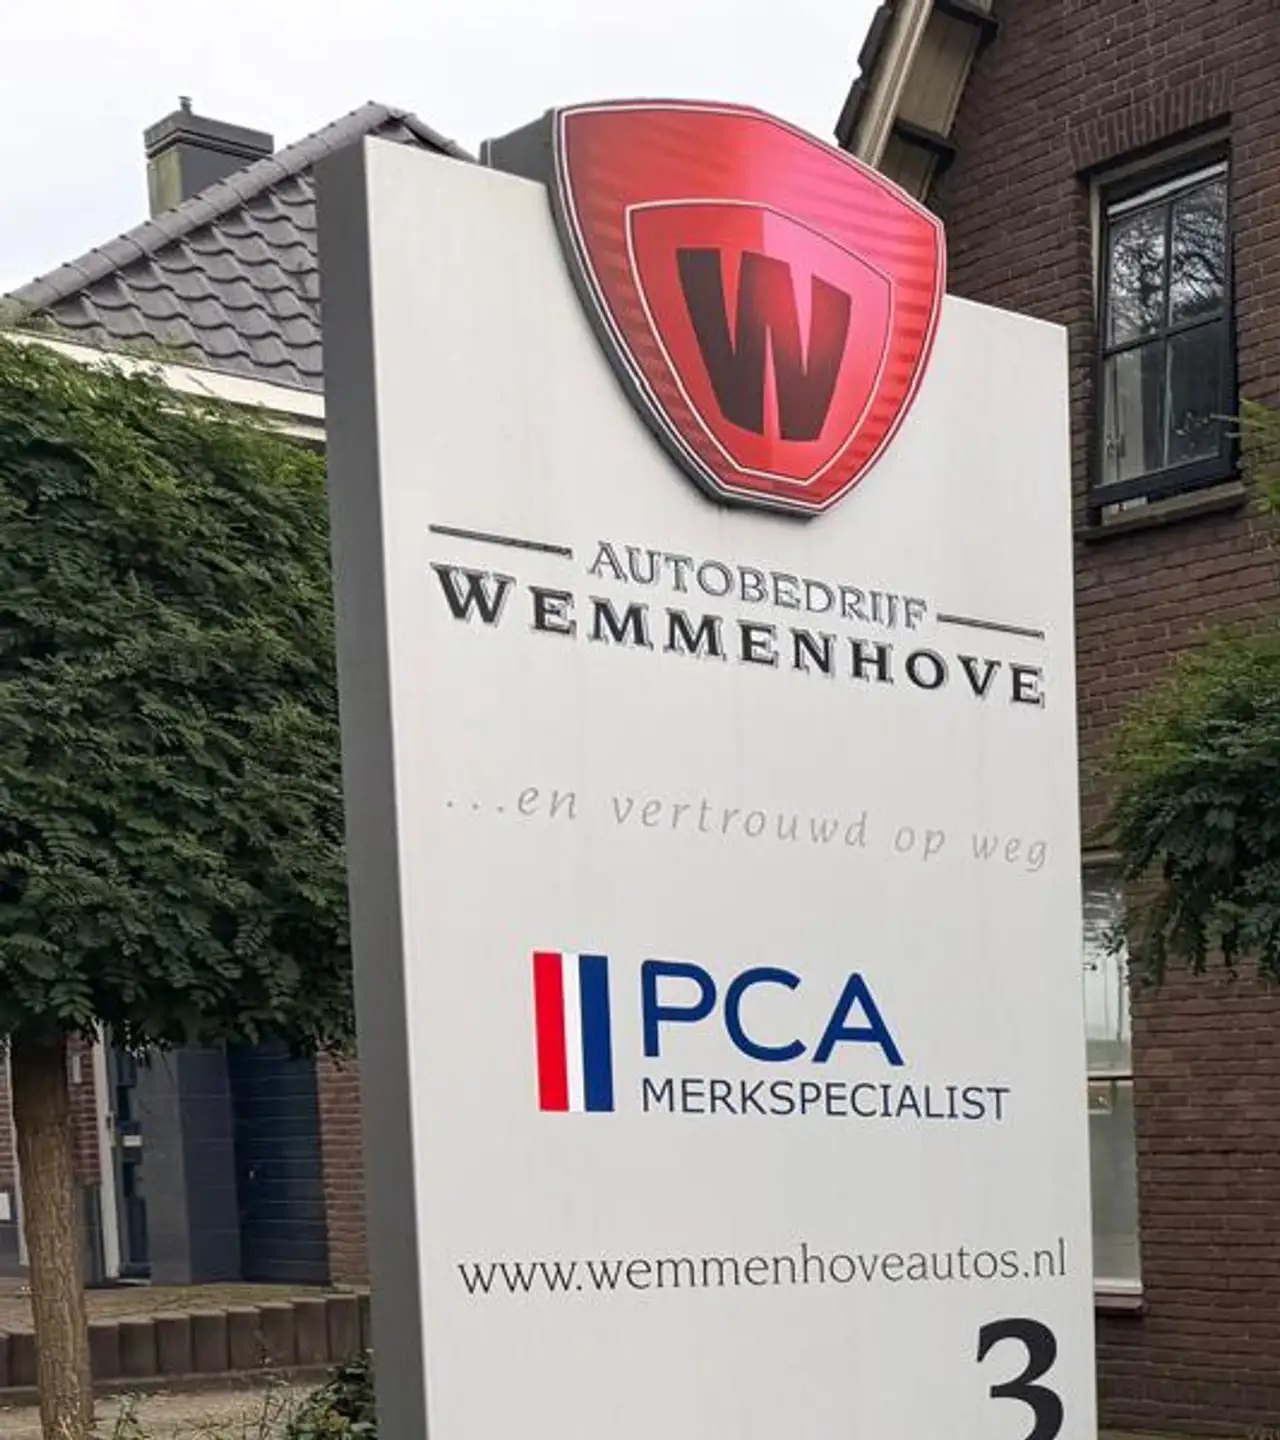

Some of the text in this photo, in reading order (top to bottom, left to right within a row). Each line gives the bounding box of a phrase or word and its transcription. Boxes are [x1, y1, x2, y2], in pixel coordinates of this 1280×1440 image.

[588, 540, 930, 630] AUTOBEDRIJF
[428, 561, 1046, 707] WEMMENHOVE
[611, 792, 869, 848] vertrouwd
[892, 823, 947, 862] op
[971, 834, 1049, 873] weg
[640, 958, 906, 1068] PCA
[641, 1077, 1012, 1122] MERKSPECIALIST
[457, 1236, 1068, 1296] www.wemmenhoveautos.nl
